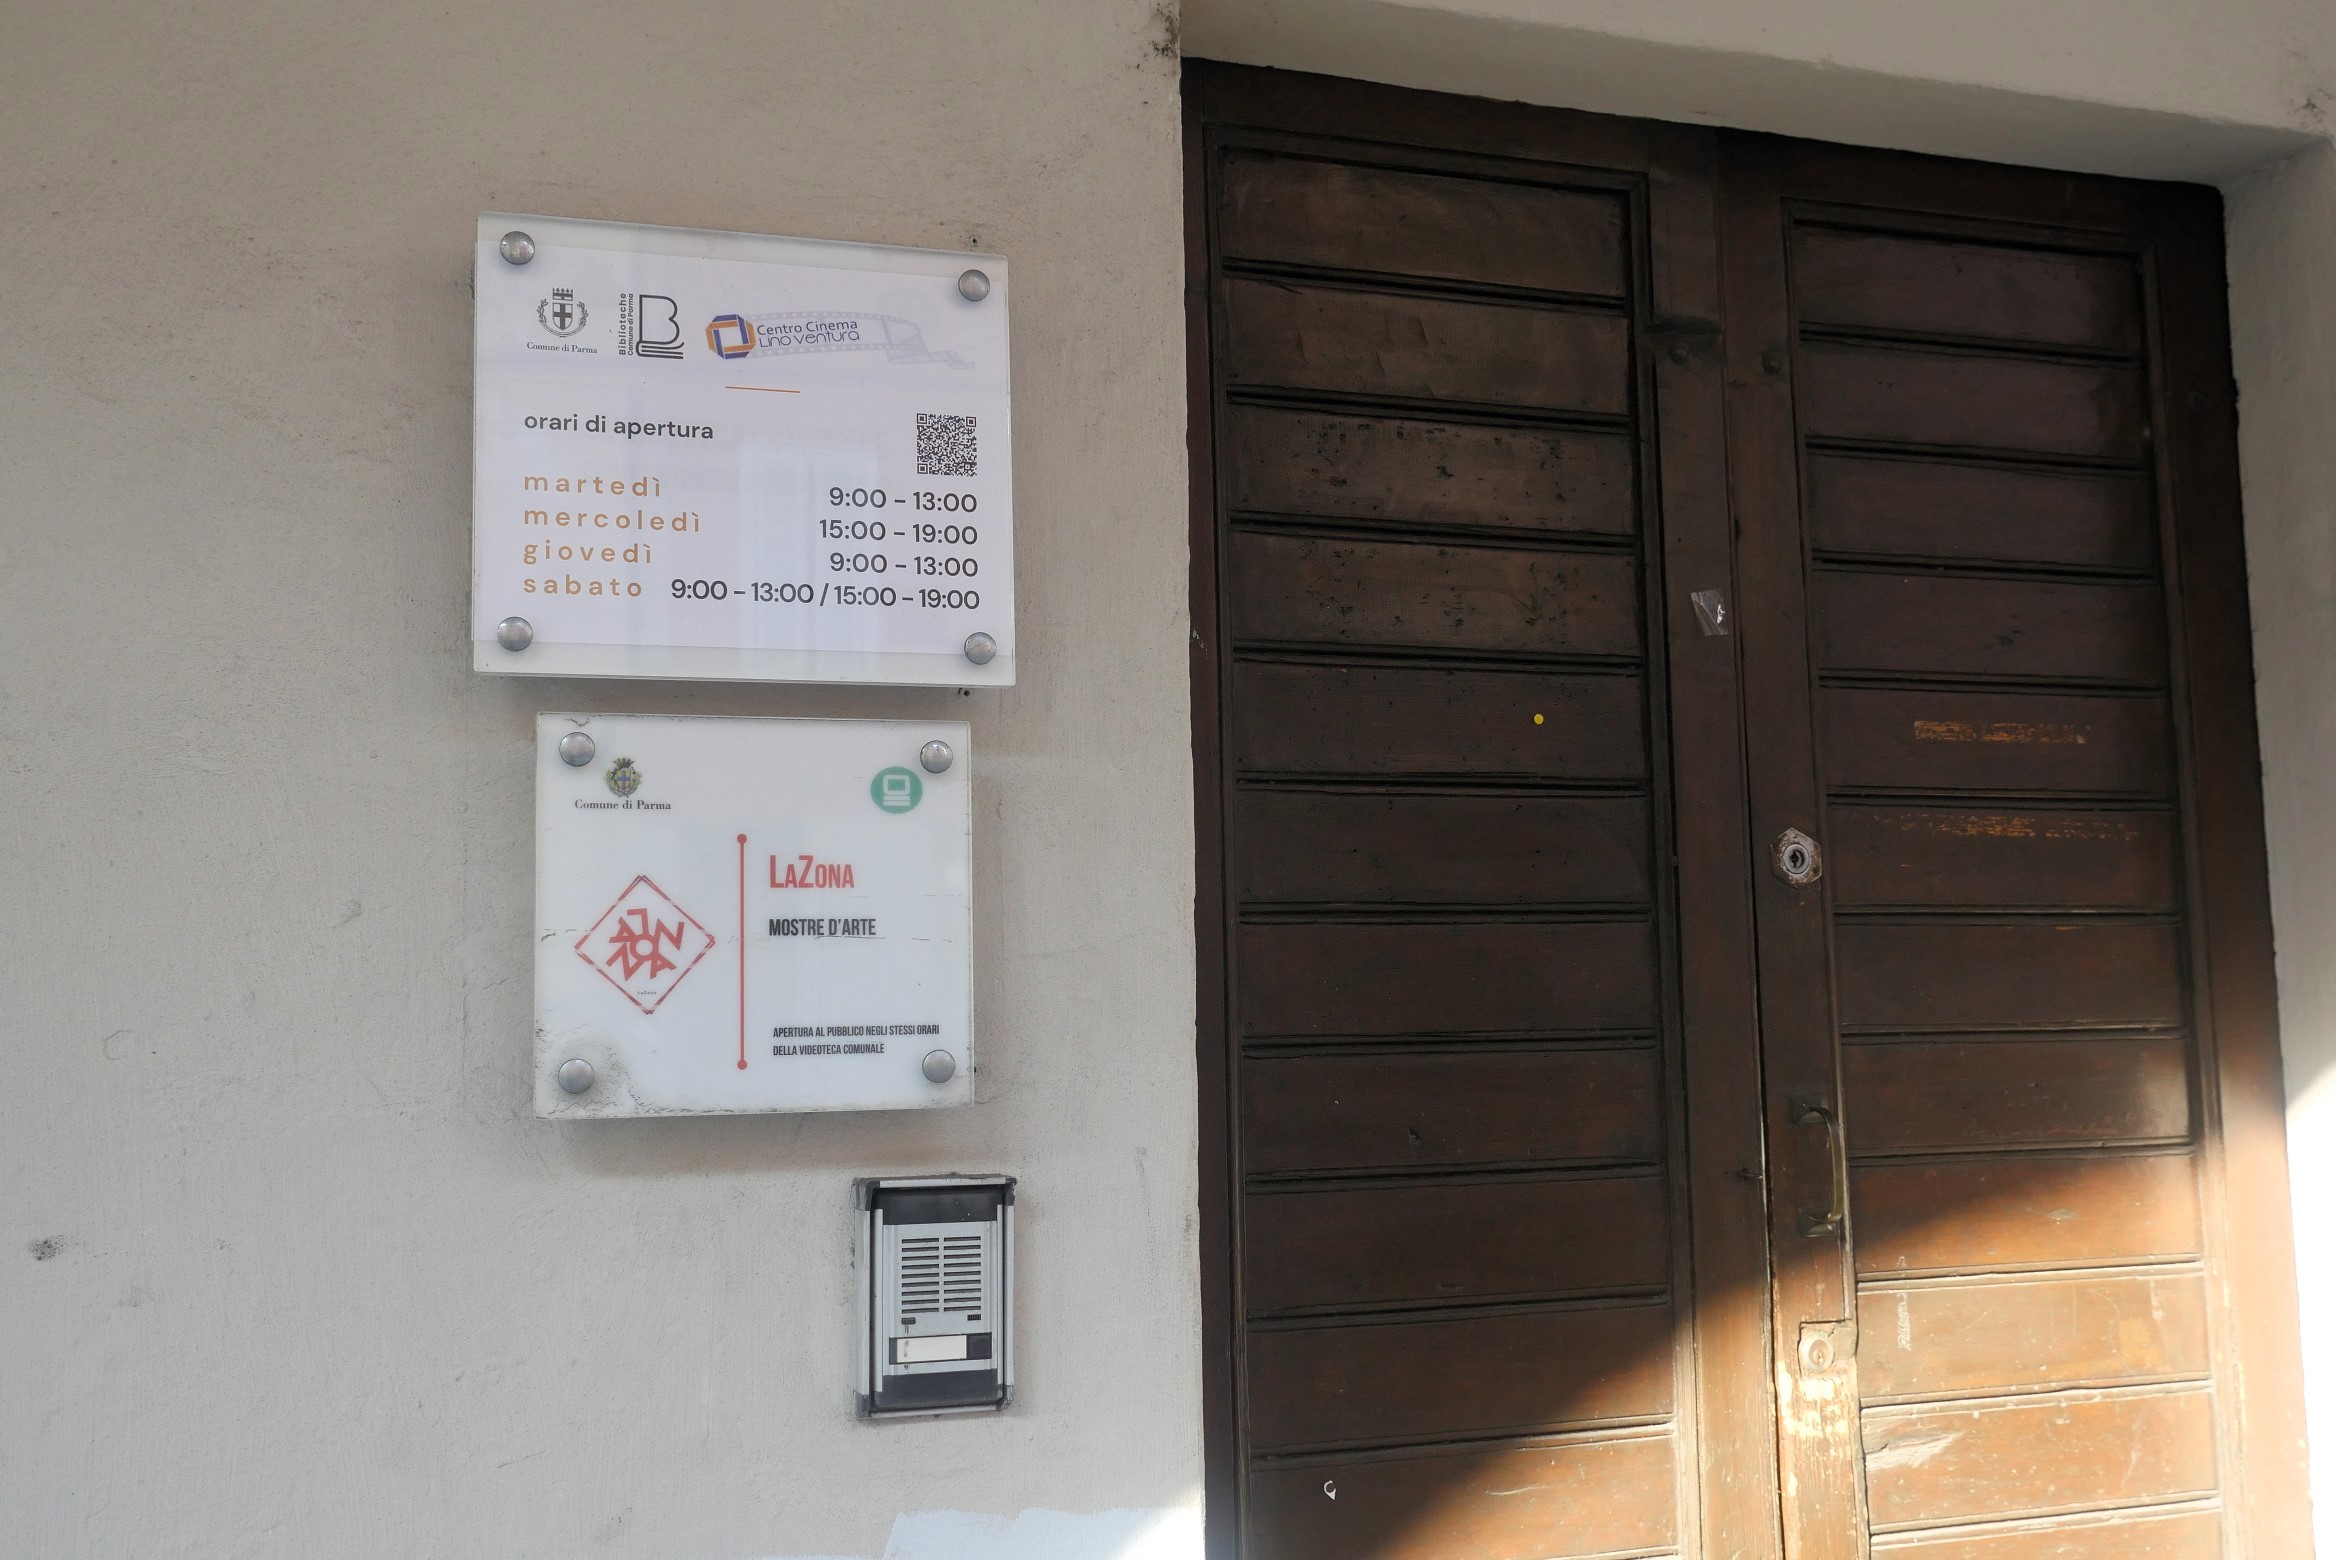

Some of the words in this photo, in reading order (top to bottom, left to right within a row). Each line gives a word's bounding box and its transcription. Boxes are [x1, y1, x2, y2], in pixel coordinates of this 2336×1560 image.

[618, 293, 627, 355] Biblioteche
[757, 324, 803, 336] Centro
[806, 320, 859, 333] Cinema
[526, 341, 560, 352] Comune
[561, 343, 571, 353] di
[571, 344, 598, 355] Parma
[525, 414, 577, 431] orari
[586, 415, 606, 432] di
[614, 421, 713, 439] apertura
[525, 476, 659, 497] martedì
[830, 487, 886, 508] 9:00
[913, 492, 977, 512] 13:00
[525, 510, 699, 532] mercoledì
[820, 519, 886, 540] 15:00
[913, 524, 977, 545] 19:00
[524, 540, 650, 565] giovedì
[830, 553, 887, 573] 9:00
[914, 556, 978, 577] 13:00
[524, 574, 641, 597] sabato
[672, 579, 727, 600] 9:00
[751, 582, 814, 603] 13:00
[834, 586, 896, 606] 15:00
[919, 589, 979, 609] 19:00
[575, 800, 619, 809] Comune
[622, 800, 632, 809] di
[637, 800, 671, 809] Parma
[769, 919, 824, 937] MOSTRE
[827, 919, 876, 937] D'ARTE
[773, 1026, 814, 1038] APERTURA
[815, 1026, 826, 1038] AL
[827, 1025, 865, 1037] PUBBLICO
[866, 1025, 888, 1036] NEGLI
[890, 1024, 916, 1036] STESSI
[917, 1024, 940, 1035] ORARI
[773, 1045, 798, 1056] DELLA
[799, 1044, 842, 1056] VIDEOTECA
[843, 1043, 885, 1055] COMUNALE
